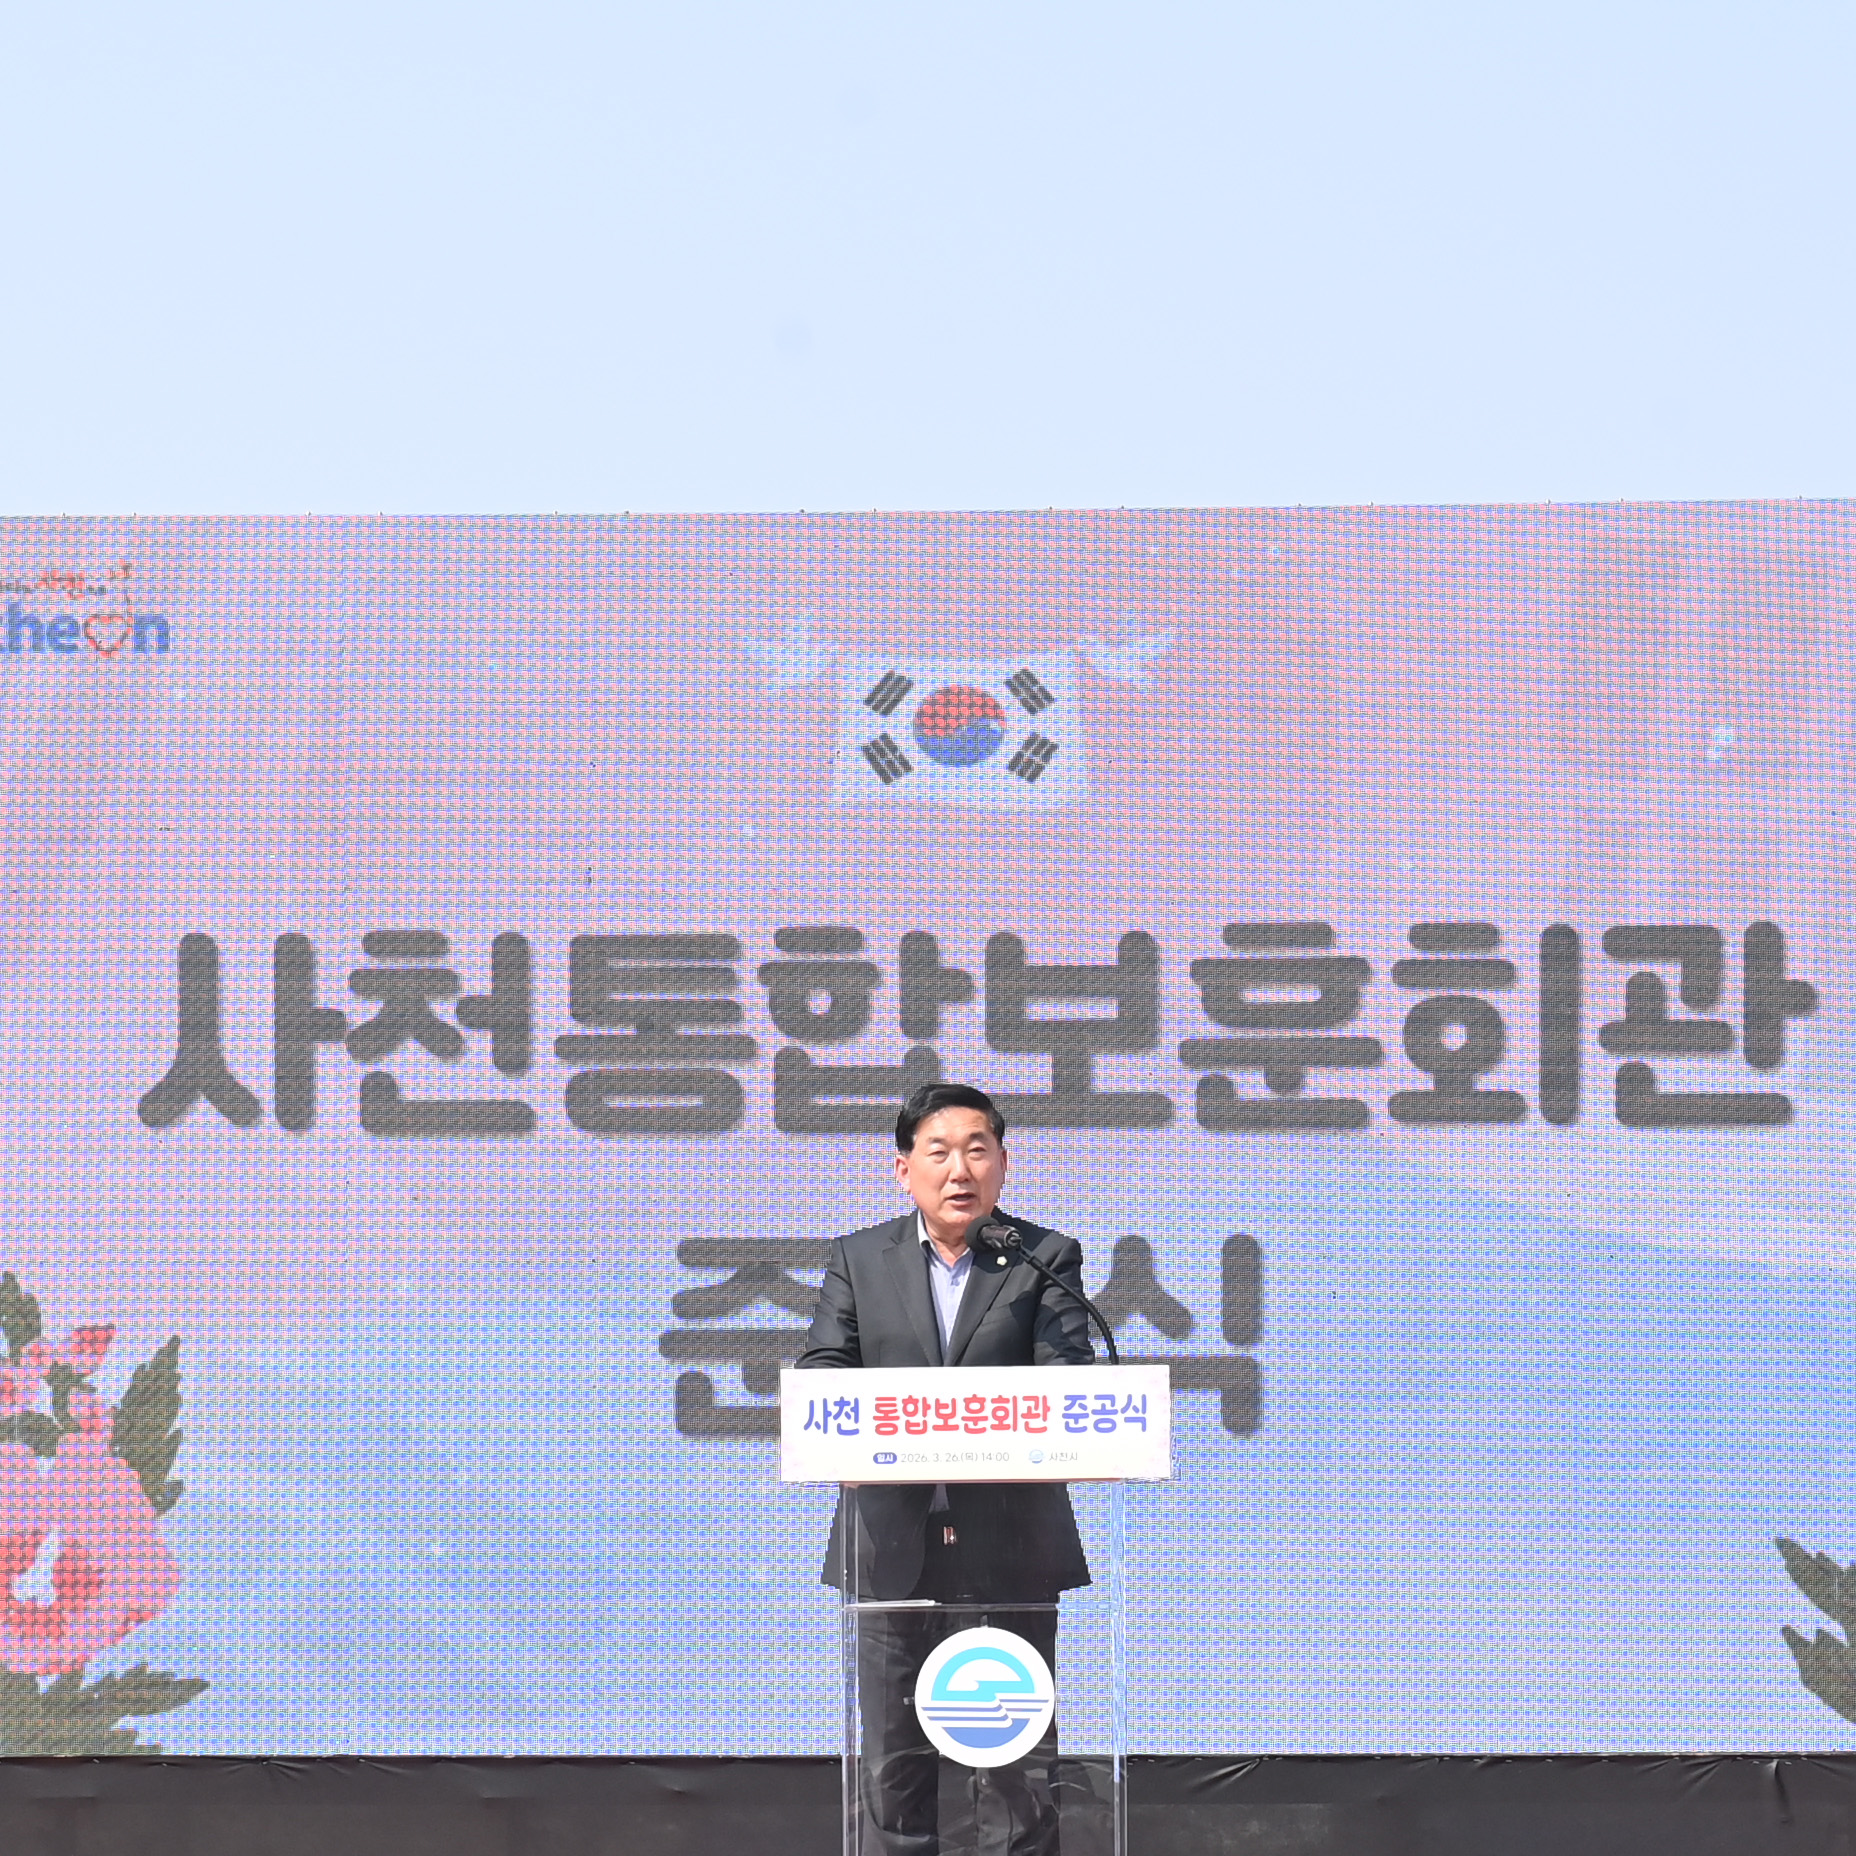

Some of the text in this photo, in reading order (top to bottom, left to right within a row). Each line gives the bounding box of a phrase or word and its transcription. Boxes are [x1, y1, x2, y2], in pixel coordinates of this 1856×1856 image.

[135, 922, 1819, 1136] 사천통합보훈회관
[657, 1233, 1264, 1438] 준식
[803, 1393, 1147, 1436] 사천 통합보훈회관 준공식
